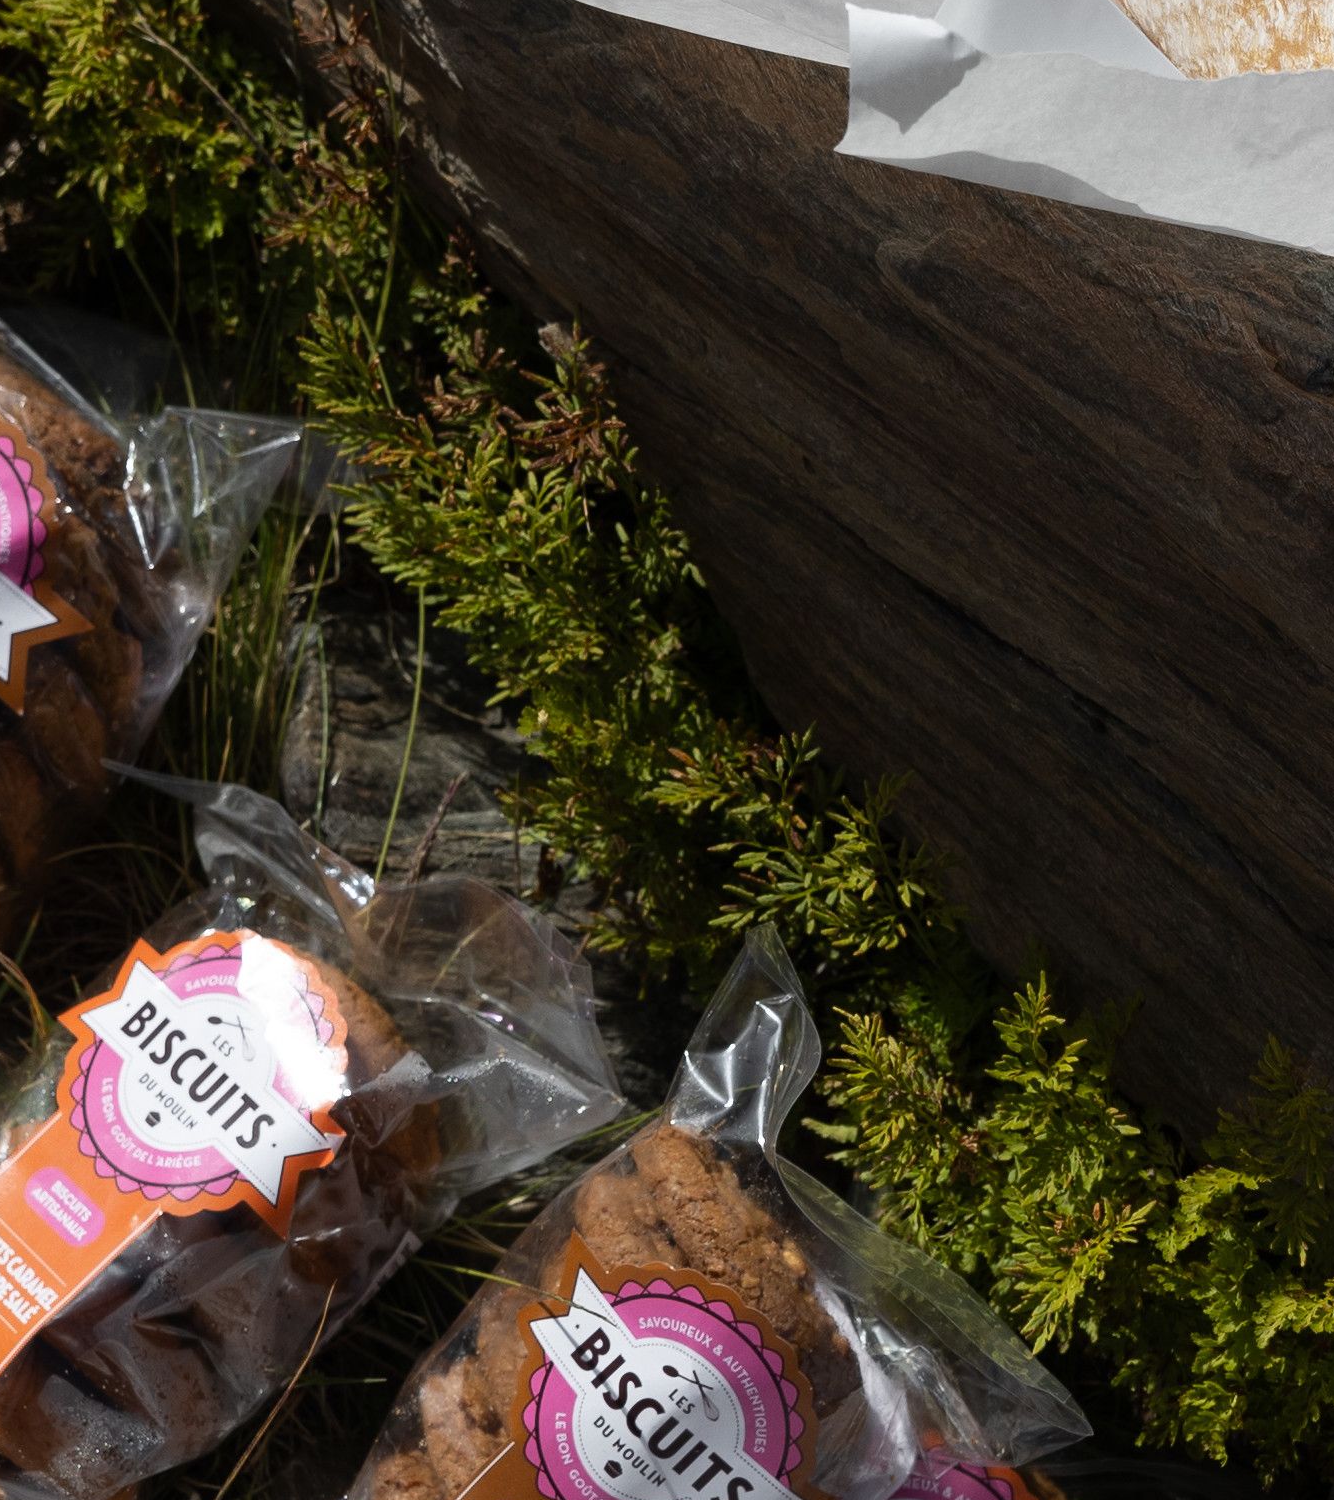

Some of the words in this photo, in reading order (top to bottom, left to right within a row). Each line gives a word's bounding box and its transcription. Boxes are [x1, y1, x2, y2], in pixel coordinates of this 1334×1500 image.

[212, 1034, 234, 1057] LES
[121, 1001, 275, 1148] BISCUITS
[138, 1073, 156, 1091] DU
[156, 1091, 198, 1130] MOULIN
[31, 1187, 87, 1241] ARTISANAUX
[51, 1180, 92, 1223] BISCUITS
[6, 1256, 58, 1312] CARAMEL
[638, 1317, 713, 1348] SAVOUREUX
[713, 1344, 723, 1357] &
[723, 1355, 765, 1453] AUTHENTIQUES
[668, 1388, 695, 1415] LES
[555, 1412, 567, 1429] LE
[556, 1431, 574, 1465] BON
[594, 1416, 613, 1438] DU
[613, 1438, 666, 1487] MOULIN
